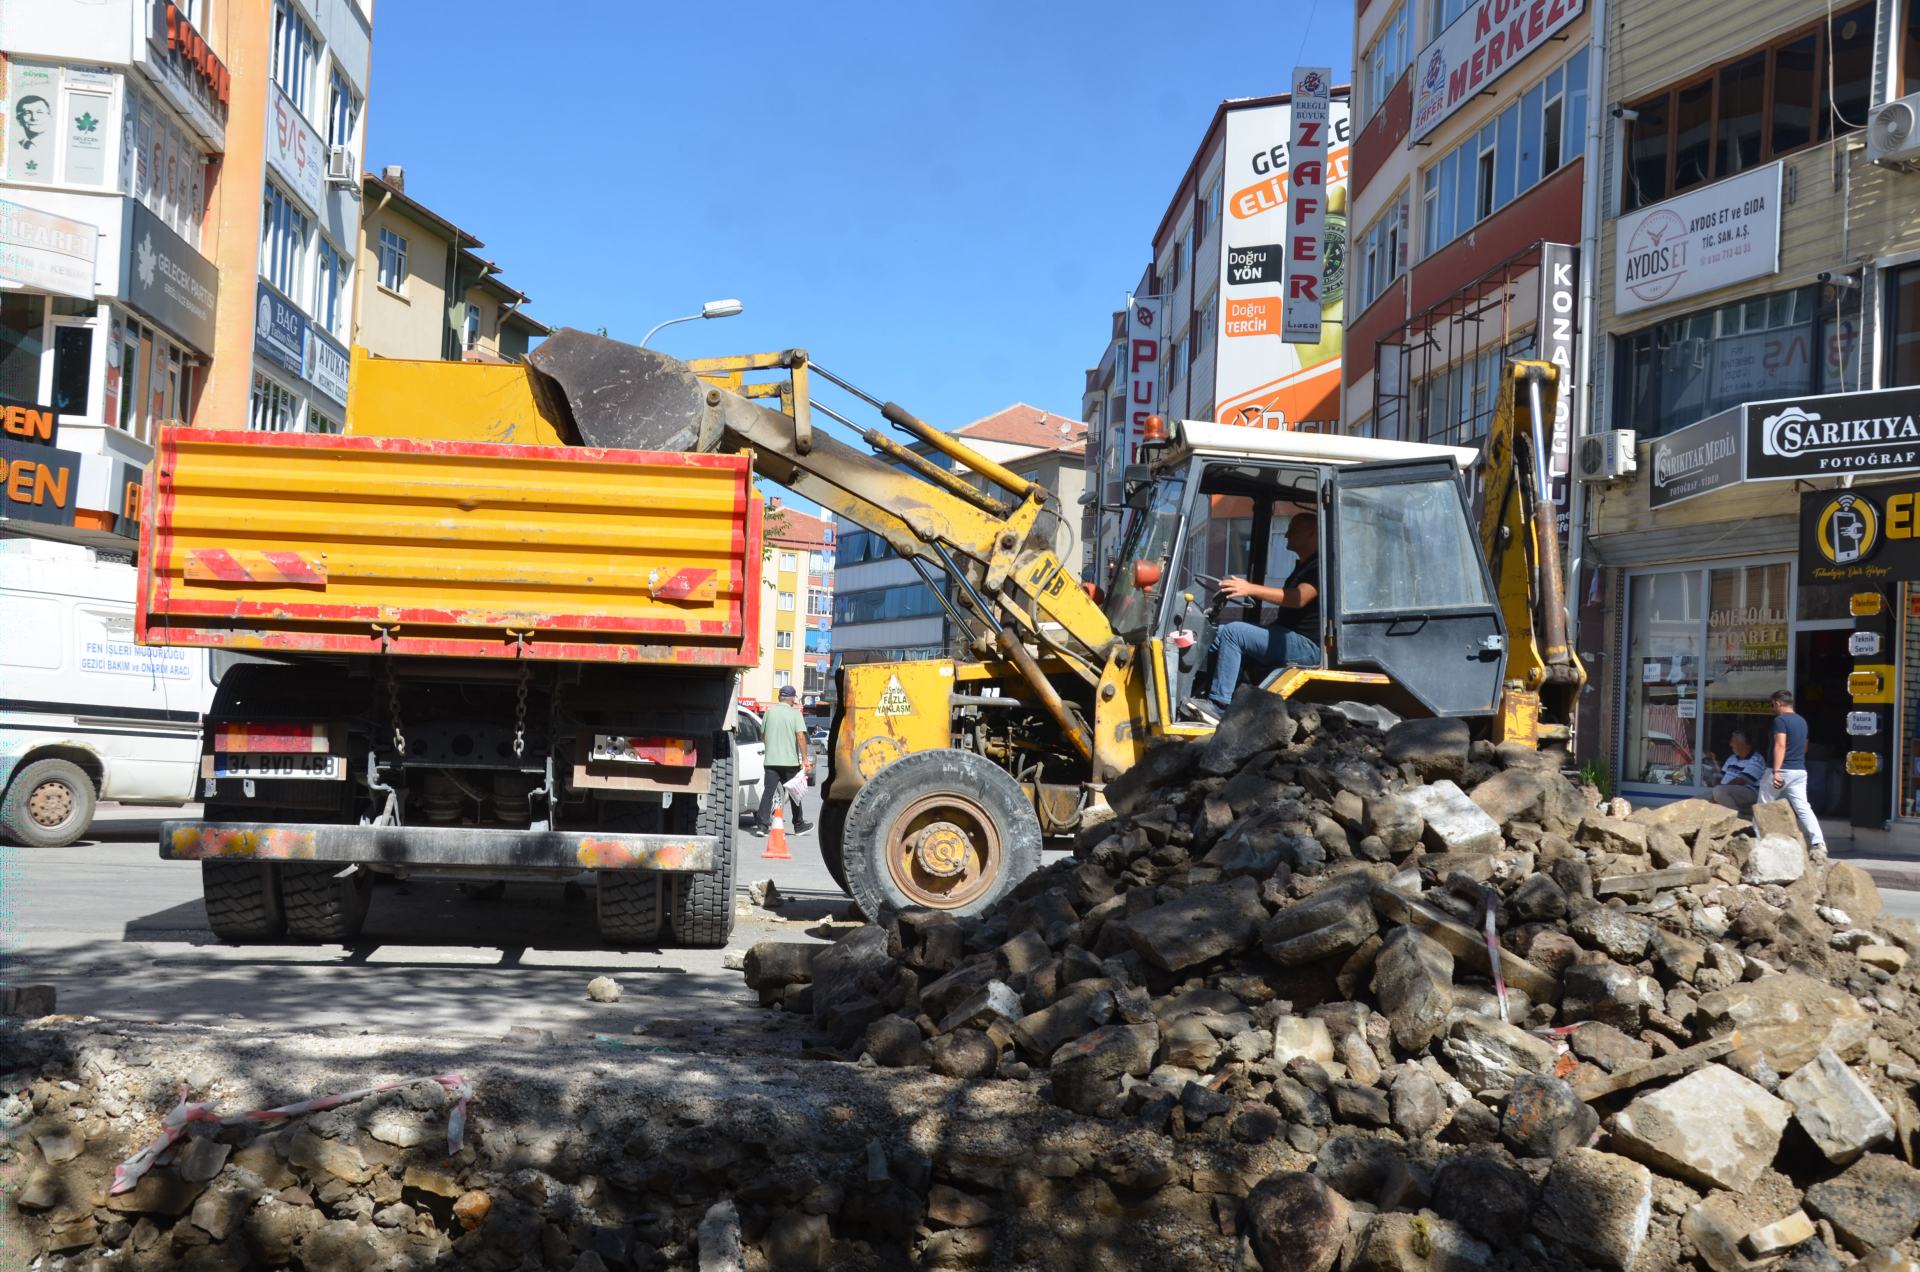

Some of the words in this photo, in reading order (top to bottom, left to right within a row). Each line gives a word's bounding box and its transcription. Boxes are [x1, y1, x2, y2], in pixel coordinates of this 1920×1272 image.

[1296, 111, 1326, 120] BÜYÜK
[1290, 122, 1325, 303] ZAFER
[1690, 213, 1716, 234] AYDOS
[1719, 208, 1729, 224] ET
[1731, 207, 1741, 220] ve
[1744, 196, 1765, 216] GIDA
[1229, 251, 1267, 266] Doğru
[1625, 246, 1669, 283] AYDOS
[1671, 240, 1688, 268] ET
[159, 253, 191, 293] GELECEK
[1233, 266, 1262, 281] YÖN
[1231, 303, 1266, 317] Doğru
[276, 303, 298, 335] BAG
[1226, 317, 1267, 333] TERCİH
[1784, 415, 1920, 450] SARIKIYA
[1660, 446, 1704, 481] SARIKIYAK
[1704, 432, 1736, 467] MEDİA
[1819, 451, 1916, 469] FOTOĞRAF
[1855, 635, 1875, 643] Teknik
[86, 643, 103, 653] FEN
[1855, 645, 1874, 653] Servis
[81, 658, 106, 669] GEZİCİ
[107, 661, 130, 671] BAKIM
[141, 663, 167, 674] ONARIM
[170, 665, 190, 675] ARACI
[228, 755, 250, 775] 34
[260, 756, 293, 775] BVD
[301, 756, 334, 776] 468
